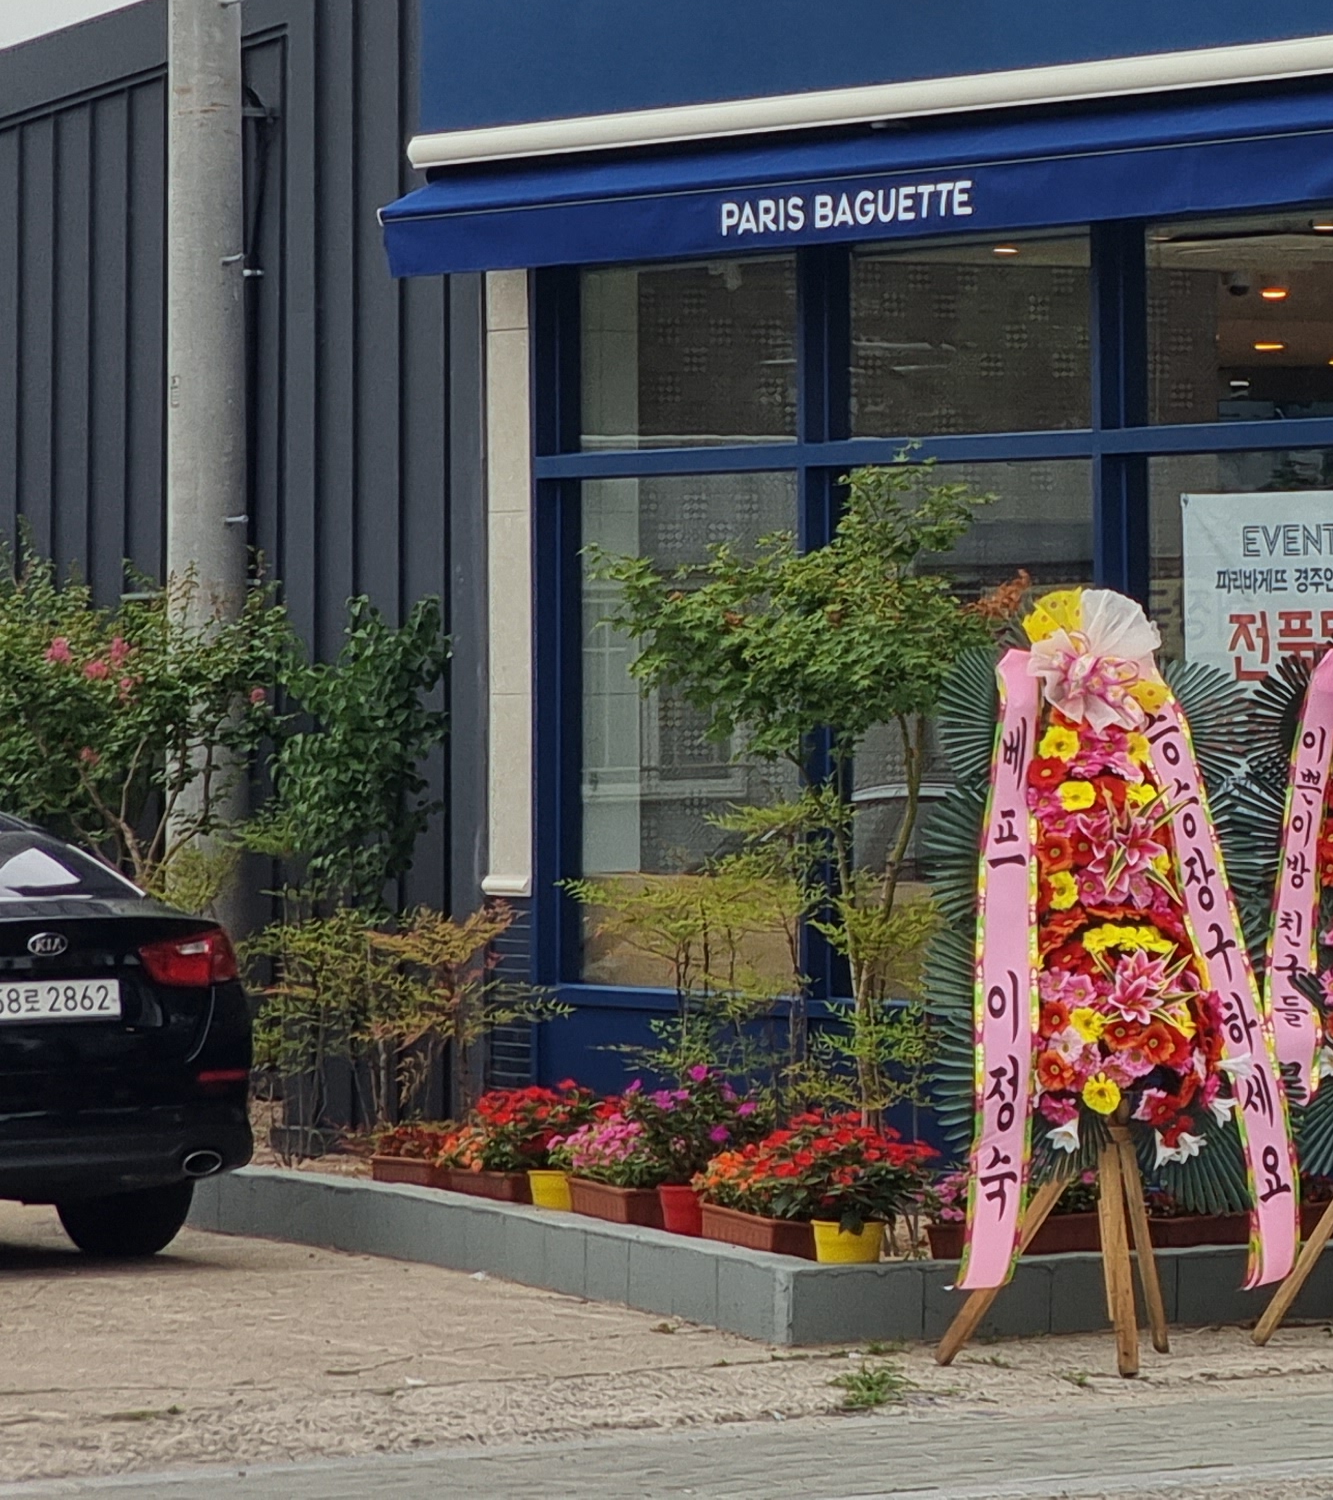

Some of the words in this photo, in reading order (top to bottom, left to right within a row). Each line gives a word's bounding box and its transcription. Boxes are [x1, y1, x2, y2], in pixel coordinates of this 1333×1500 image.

[721, 196, 805, 236] PARIS
[814, 180, 973, 229] BAGUETTE
[1215, 568, 1289, 595] 파리바게뜨
[987, 716, 1028, 870] 베프
[33, 937, 63, 953] KIA
[1273, 911, 1309, 1027] 친구들
[0, 987, 42, 1014] 8로
[46, 984, 112, 1013] 2862
[979, 970, 1021, 1222] 이정숙
